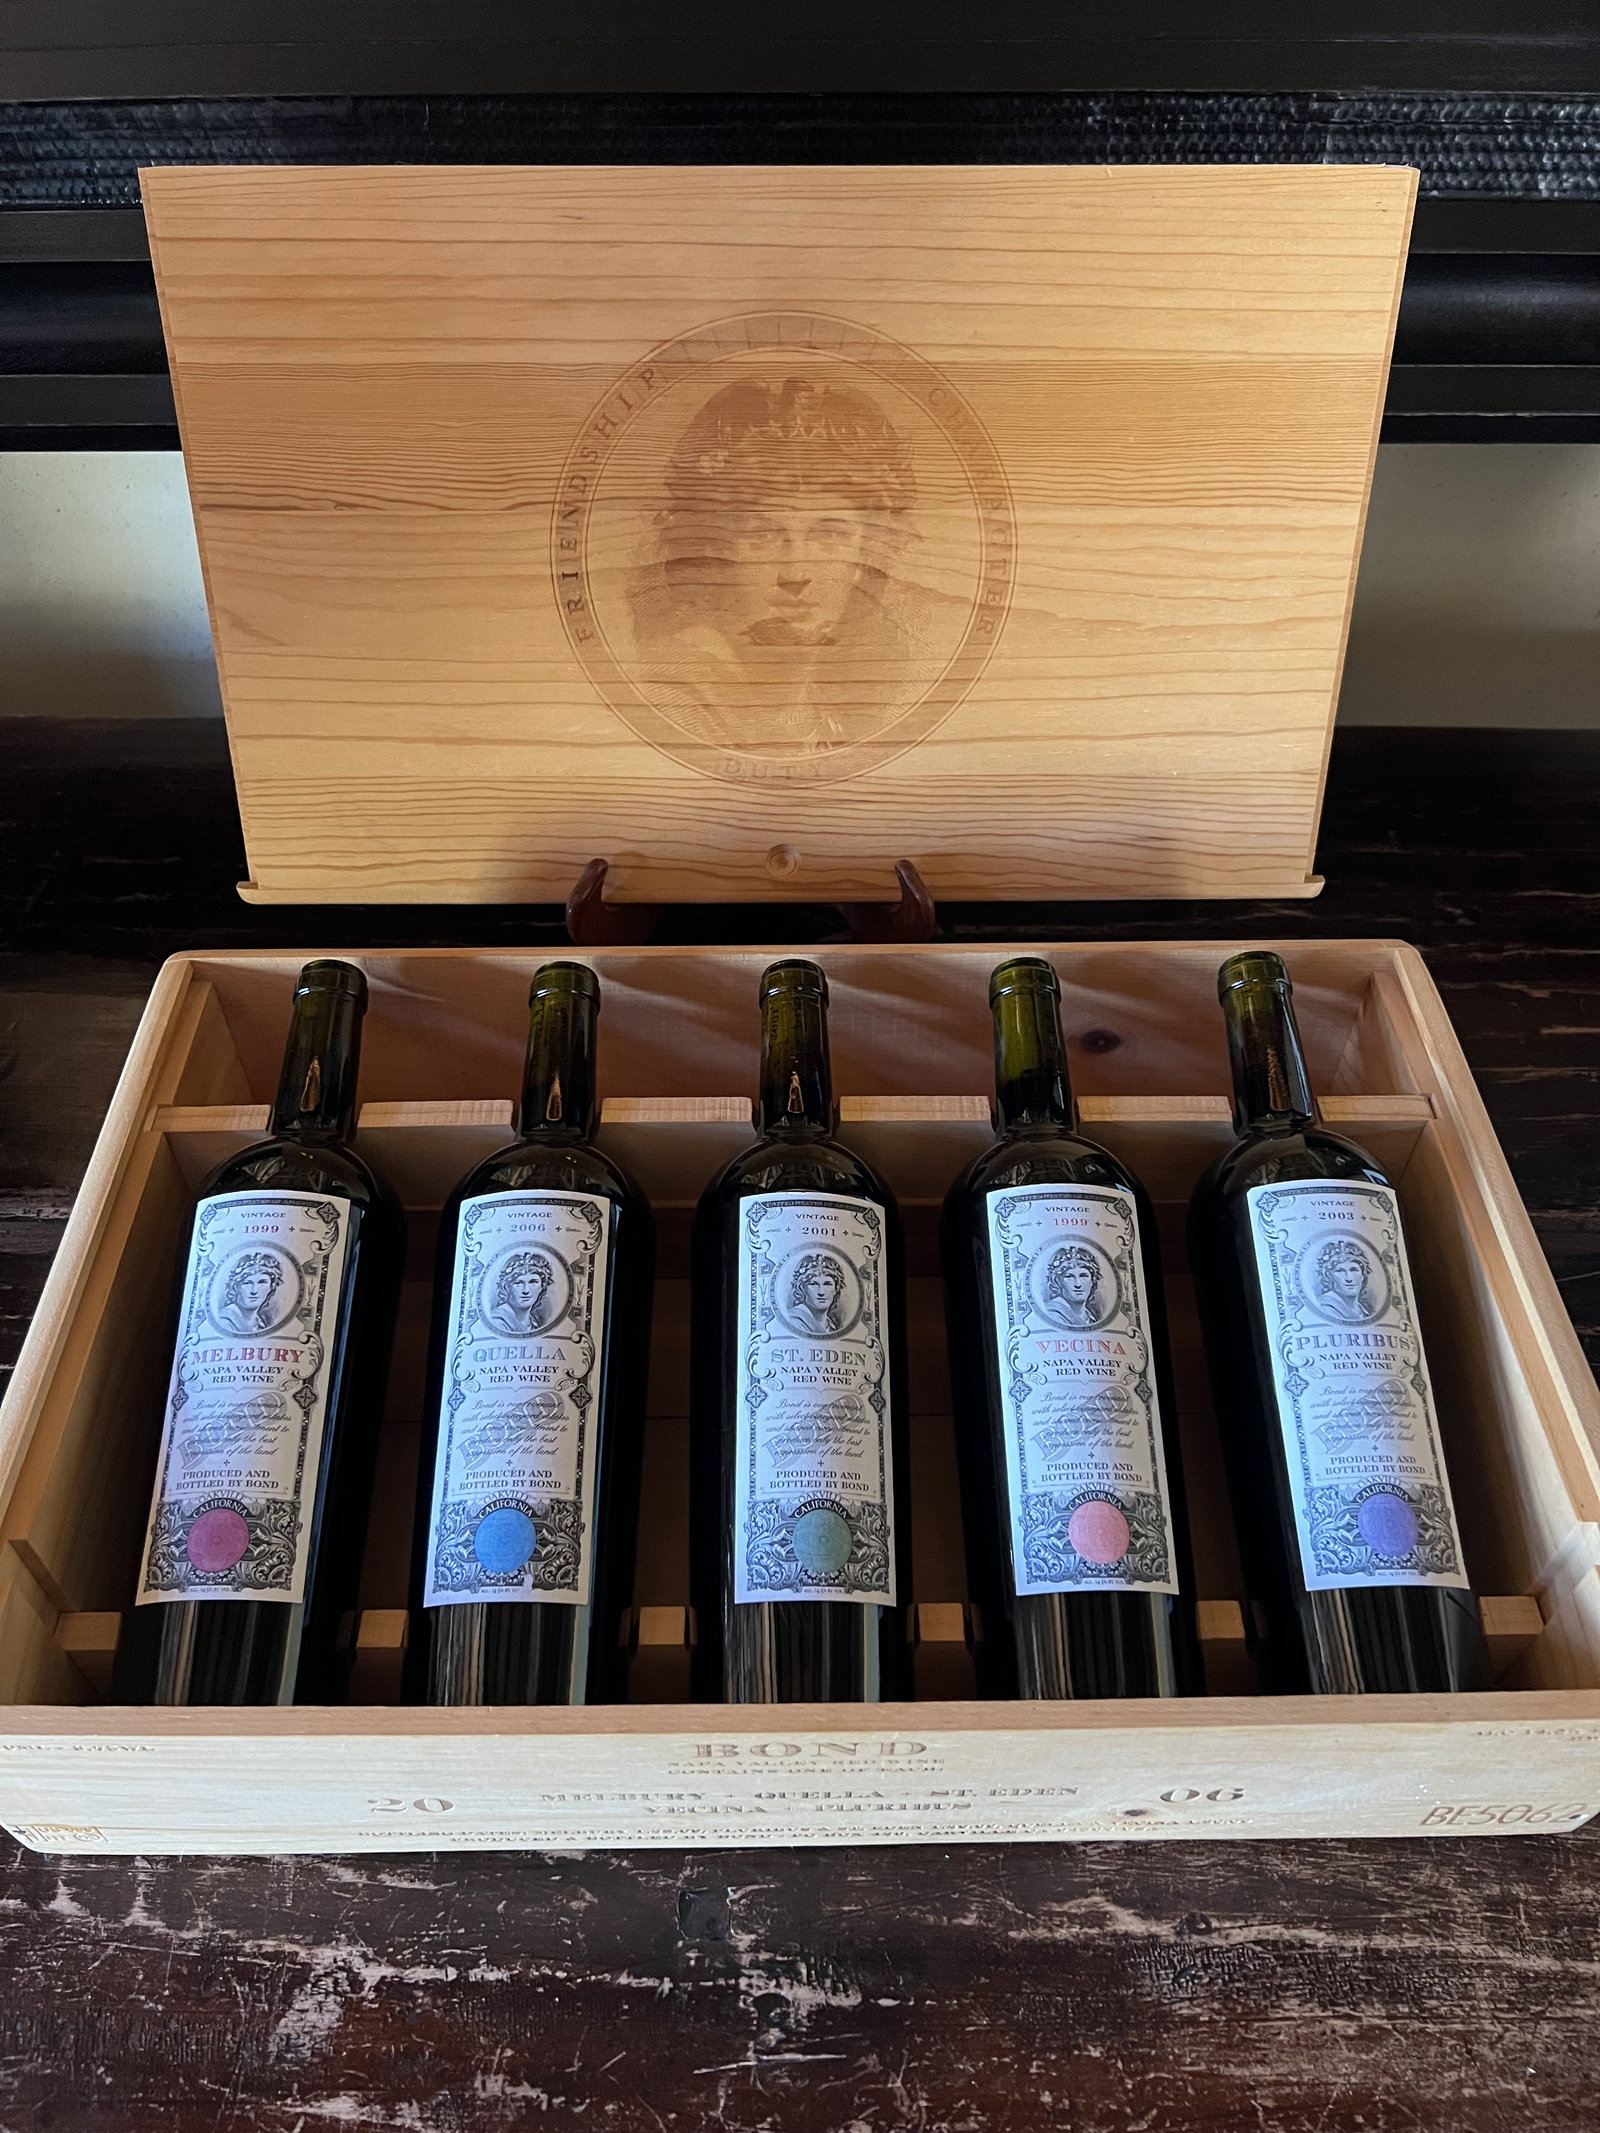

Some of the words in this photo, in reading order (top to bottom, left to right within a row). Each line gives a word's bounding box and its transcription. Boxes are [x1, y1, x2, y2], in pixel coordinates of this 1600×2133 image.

[561, 367, 655, 644] FRIENDSHIP
[725, 757, 824, 778] DUTY
[1318, 1212, 1354, 1220] 2003
[1053, 1218, 1089, 1227] 1999
[244, 1225, 279, 1233] 1999
[510, 1224, 546, 1232] 2006
[802, 1227, 836, 1236] 2001
[1035, 1339, 1127, 1355] VECINA
[1295, 1334, 1411, 1351] PLURIBUS
[191, 1347, 304, 1365] MELBURY
[473, 1346, 566, 1363] QUELLA
[771, 1349, 804, 1363] ST.
[809, 1349, 867, 1367] EDEN
[1319, 1353, 1351, 1361] NAPA
[1354, 1353, 1397, 1361] VALLEY
[1078, 1359, 1122, 1368] VALLEY
[1333, 1362, 1359, 1370] RED
[1362, 1362, 1393, 1370] WINE
[203, 1367, 231, 1375] NAPA
[236, 1366, 284, 1374] VALLEY
[480, 1366, 508, 1375] NAPA
[513, 1365, 559, 1373] VALLEY
[781, 1366, 811, 1374] NAPA
[816, 1366, 858, 1376] VALLEY
[1056, 1368, 1081, 1376] RED
[1085, 1368, 1117, 1377] WINE
[212, 1375, 236, 1383] RED
[241, 1375, 274, 1383] WINE
[490, 1375, 514, 1383] RED
[519, 1374, 551, 1383] WINE
[822, 1376, 852, 1385] WINE
[1329, 1455, 1393, 1464] PRODUCED
[1047, 1462, 1109, 1471] PRODUCED
[1111, 1463, 1133, 1471] AND
[1325, 1465, 1379, 1474] BOTTLED
[1399, 1465, 1425, 1474] BOND
[183, 1470, 242, 1479] PRODUCED
[245, 1470, 270, 1478] AND
[465, 1470, 525, 1479] PRODUCED
[528, 1470, 553, 1478] AND
[776, 1470, 837, 1478] PRODUCED
[840, 1472, 861, 1480] AND
[1041, 1472, 1094, 1481] BOTTLED
[1097, 1472, 1111, 1480] BY
[1113, 1473, 1142, 1482] BOND
[176, 1480, 224, 1490] BOTTLED
[245, 1480, 279, 1488] BOND
[459, 1480, 508, 1490] BOTTLED
[529, 1480, 562, 1489] BOND
[841, 1481, 870, 1491] BOND
[1355, 1483, 1409, 1503] CALIFORNIA
[1068, 1490, 1122, 1510] CALIFORNIA
[192, 1498, 248, 1517] CALIFORNIA
[479, 1498, 533, 1518] CALIFORNIA
[794, 1499, 848, 1518] CALIFORNIA
[696, 1742, 928, 1758] BOND
[540, 1792, 706, 1801] MELBURY
[754, 1790, 885, 1800] QUELLA
[929, 1788, 978, 1797] ST.
[988, 1787, 1080, 1796] EDEN
[1160, 1787, 1245, 1802] 06
[367, 1797, 456, 1813] 20
[643, 1805, 768, 1814] VECINA
[815, 1802, 973, 1812] PLURIBUS
[1418, 1802, 1589, 1827] BE5062
